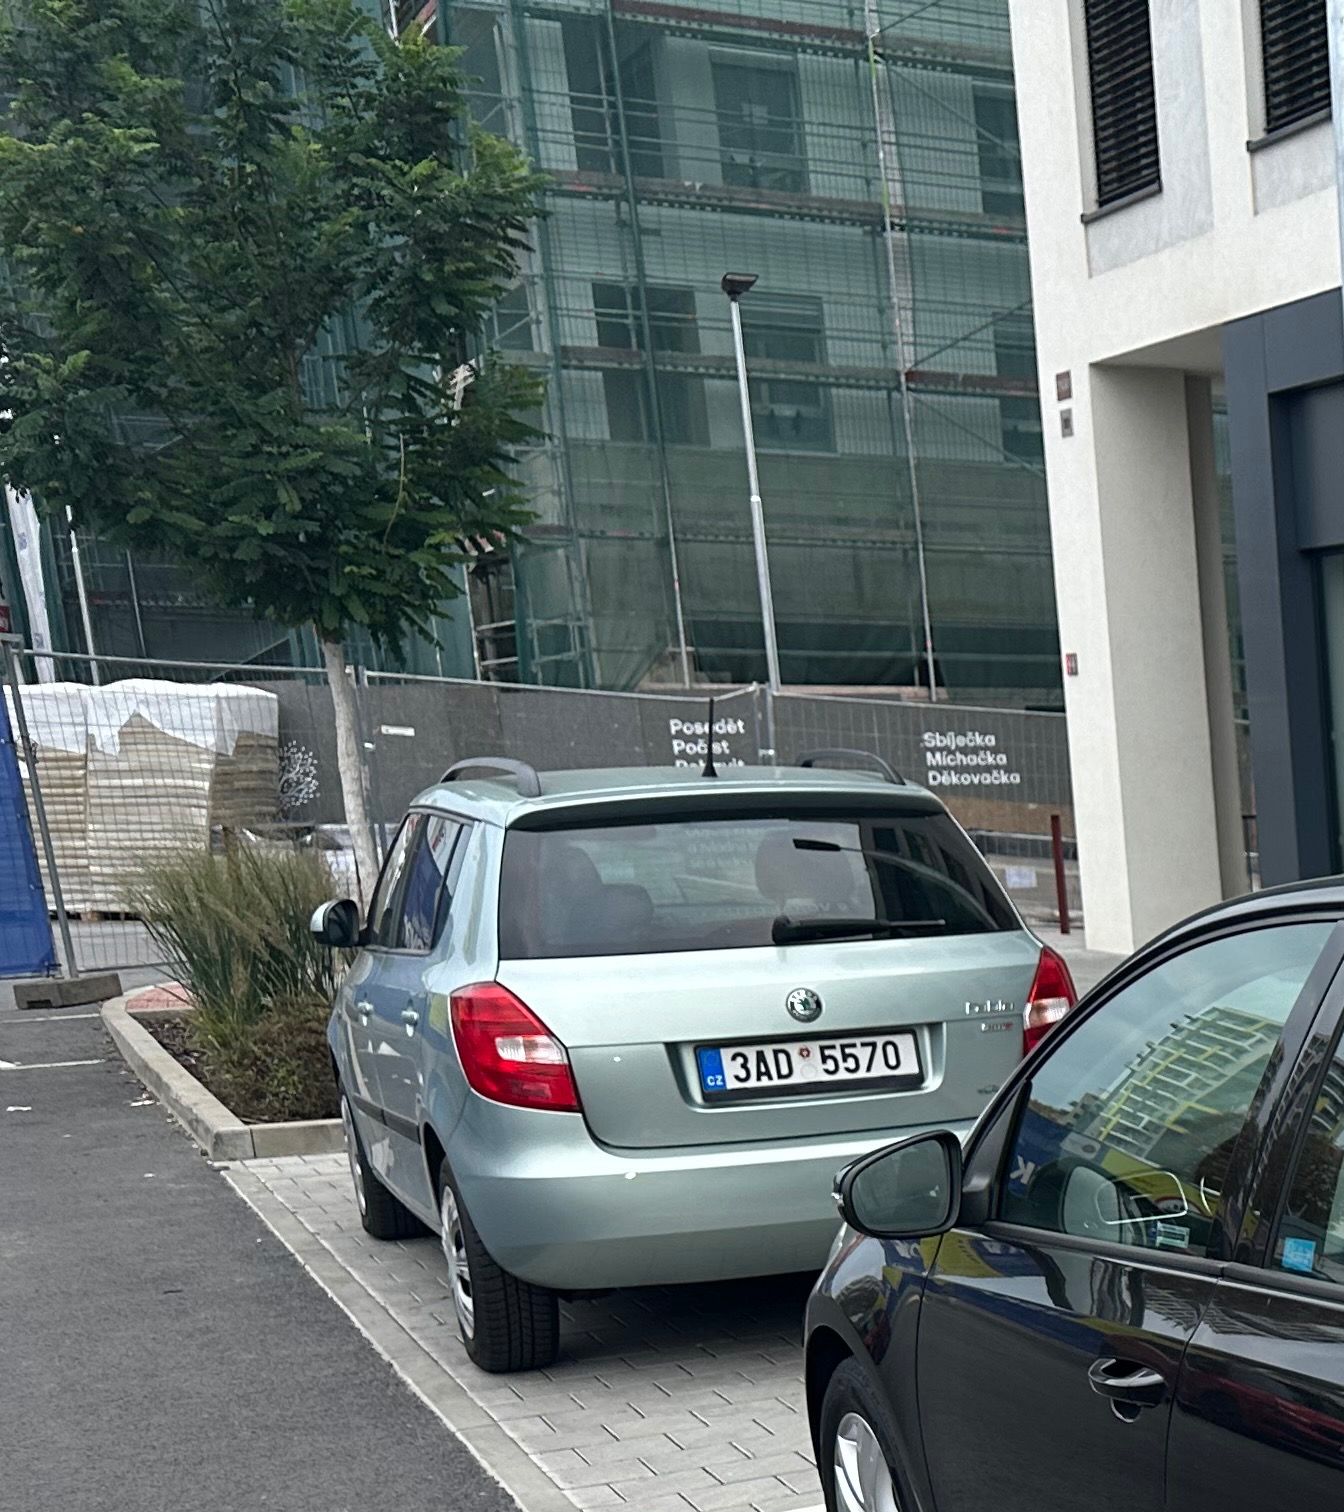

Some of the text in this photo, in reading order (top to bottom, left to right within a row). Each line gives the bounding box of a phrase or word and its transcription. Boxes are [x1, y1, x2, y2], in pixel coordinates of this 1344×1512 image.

[672, 738, 730, 755] Počst
[923, 731, 996, 750] Sbíječka
[926, 750, 1007, 766] Míchačka
[928, 769, 1020, 786] Děkovačka
[706, 1040, 901, 1087] CZ 3AD 5570
